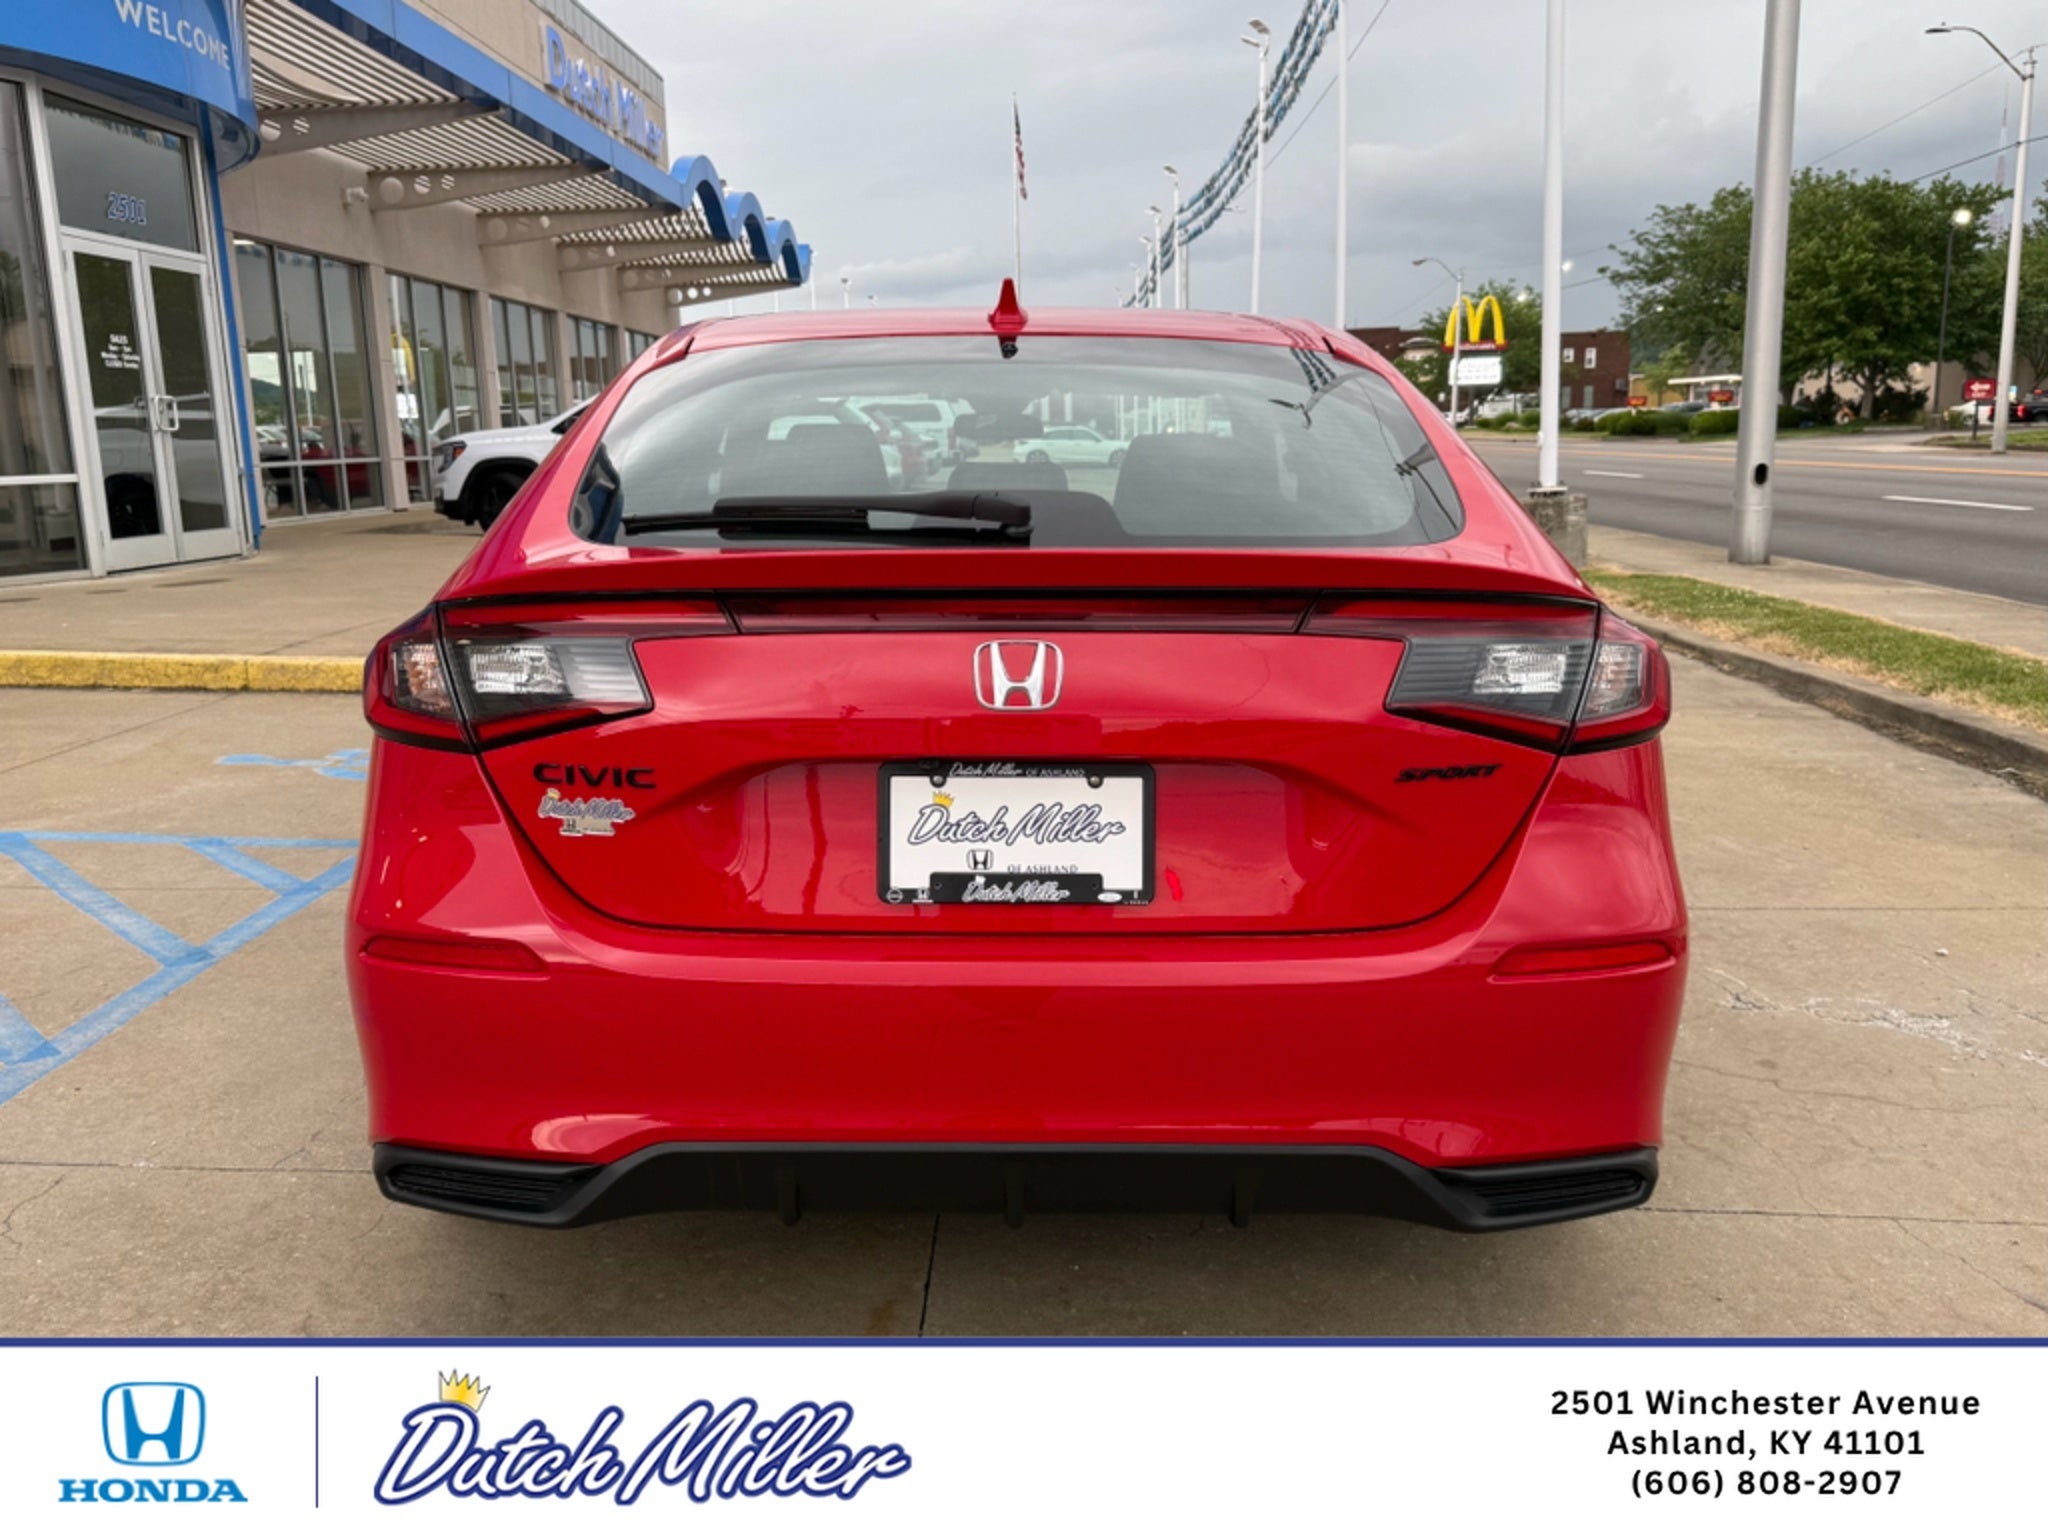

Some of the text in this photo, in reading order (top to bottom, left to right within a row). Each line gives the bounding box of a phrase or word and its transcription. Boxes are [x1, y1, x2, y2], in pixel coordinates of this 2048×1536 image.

[114, 0, 231, 72] WELCOME
[546, 25, 664, 157] Dutch Miller
[108, 191, 147, 225] 2501
[533, 762, 656, 789] CIVIC
[1394, 763, 1502, 783] SPORT
[908, 802, 1126, 846] Dutch Miller
[1007, 864, 1079, 874] OF ASHLAND
[961, 879, 1071, 903] Dutch Miller
